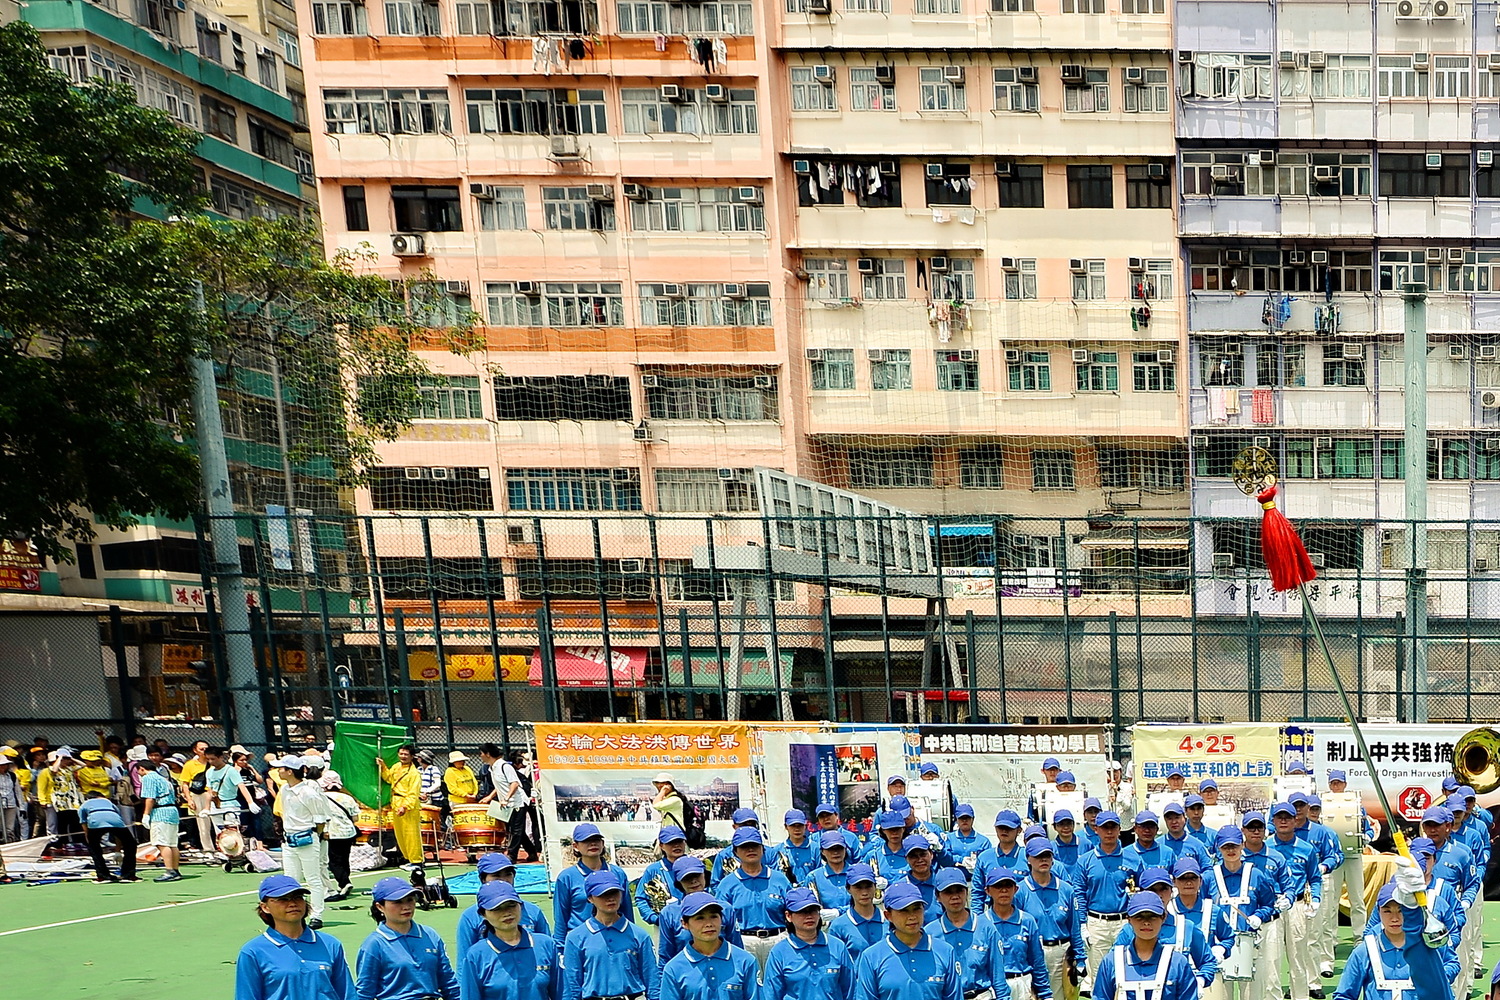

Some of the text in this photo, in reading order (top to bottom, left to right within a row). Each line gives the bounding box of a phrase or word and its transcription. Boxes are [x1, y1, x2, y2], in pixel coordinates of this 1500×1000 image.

[546, 733, 741, 751] 法輪大法洪傳世界
[924, 734, 1100, 753] 中共酷刑迫害法輪功學員
[1142, 761, 1273, 778] 最理性平和的上訪
[1382, 769, 1408, 779] Organ
[1411, 769, 1454, 777] Harvestin
